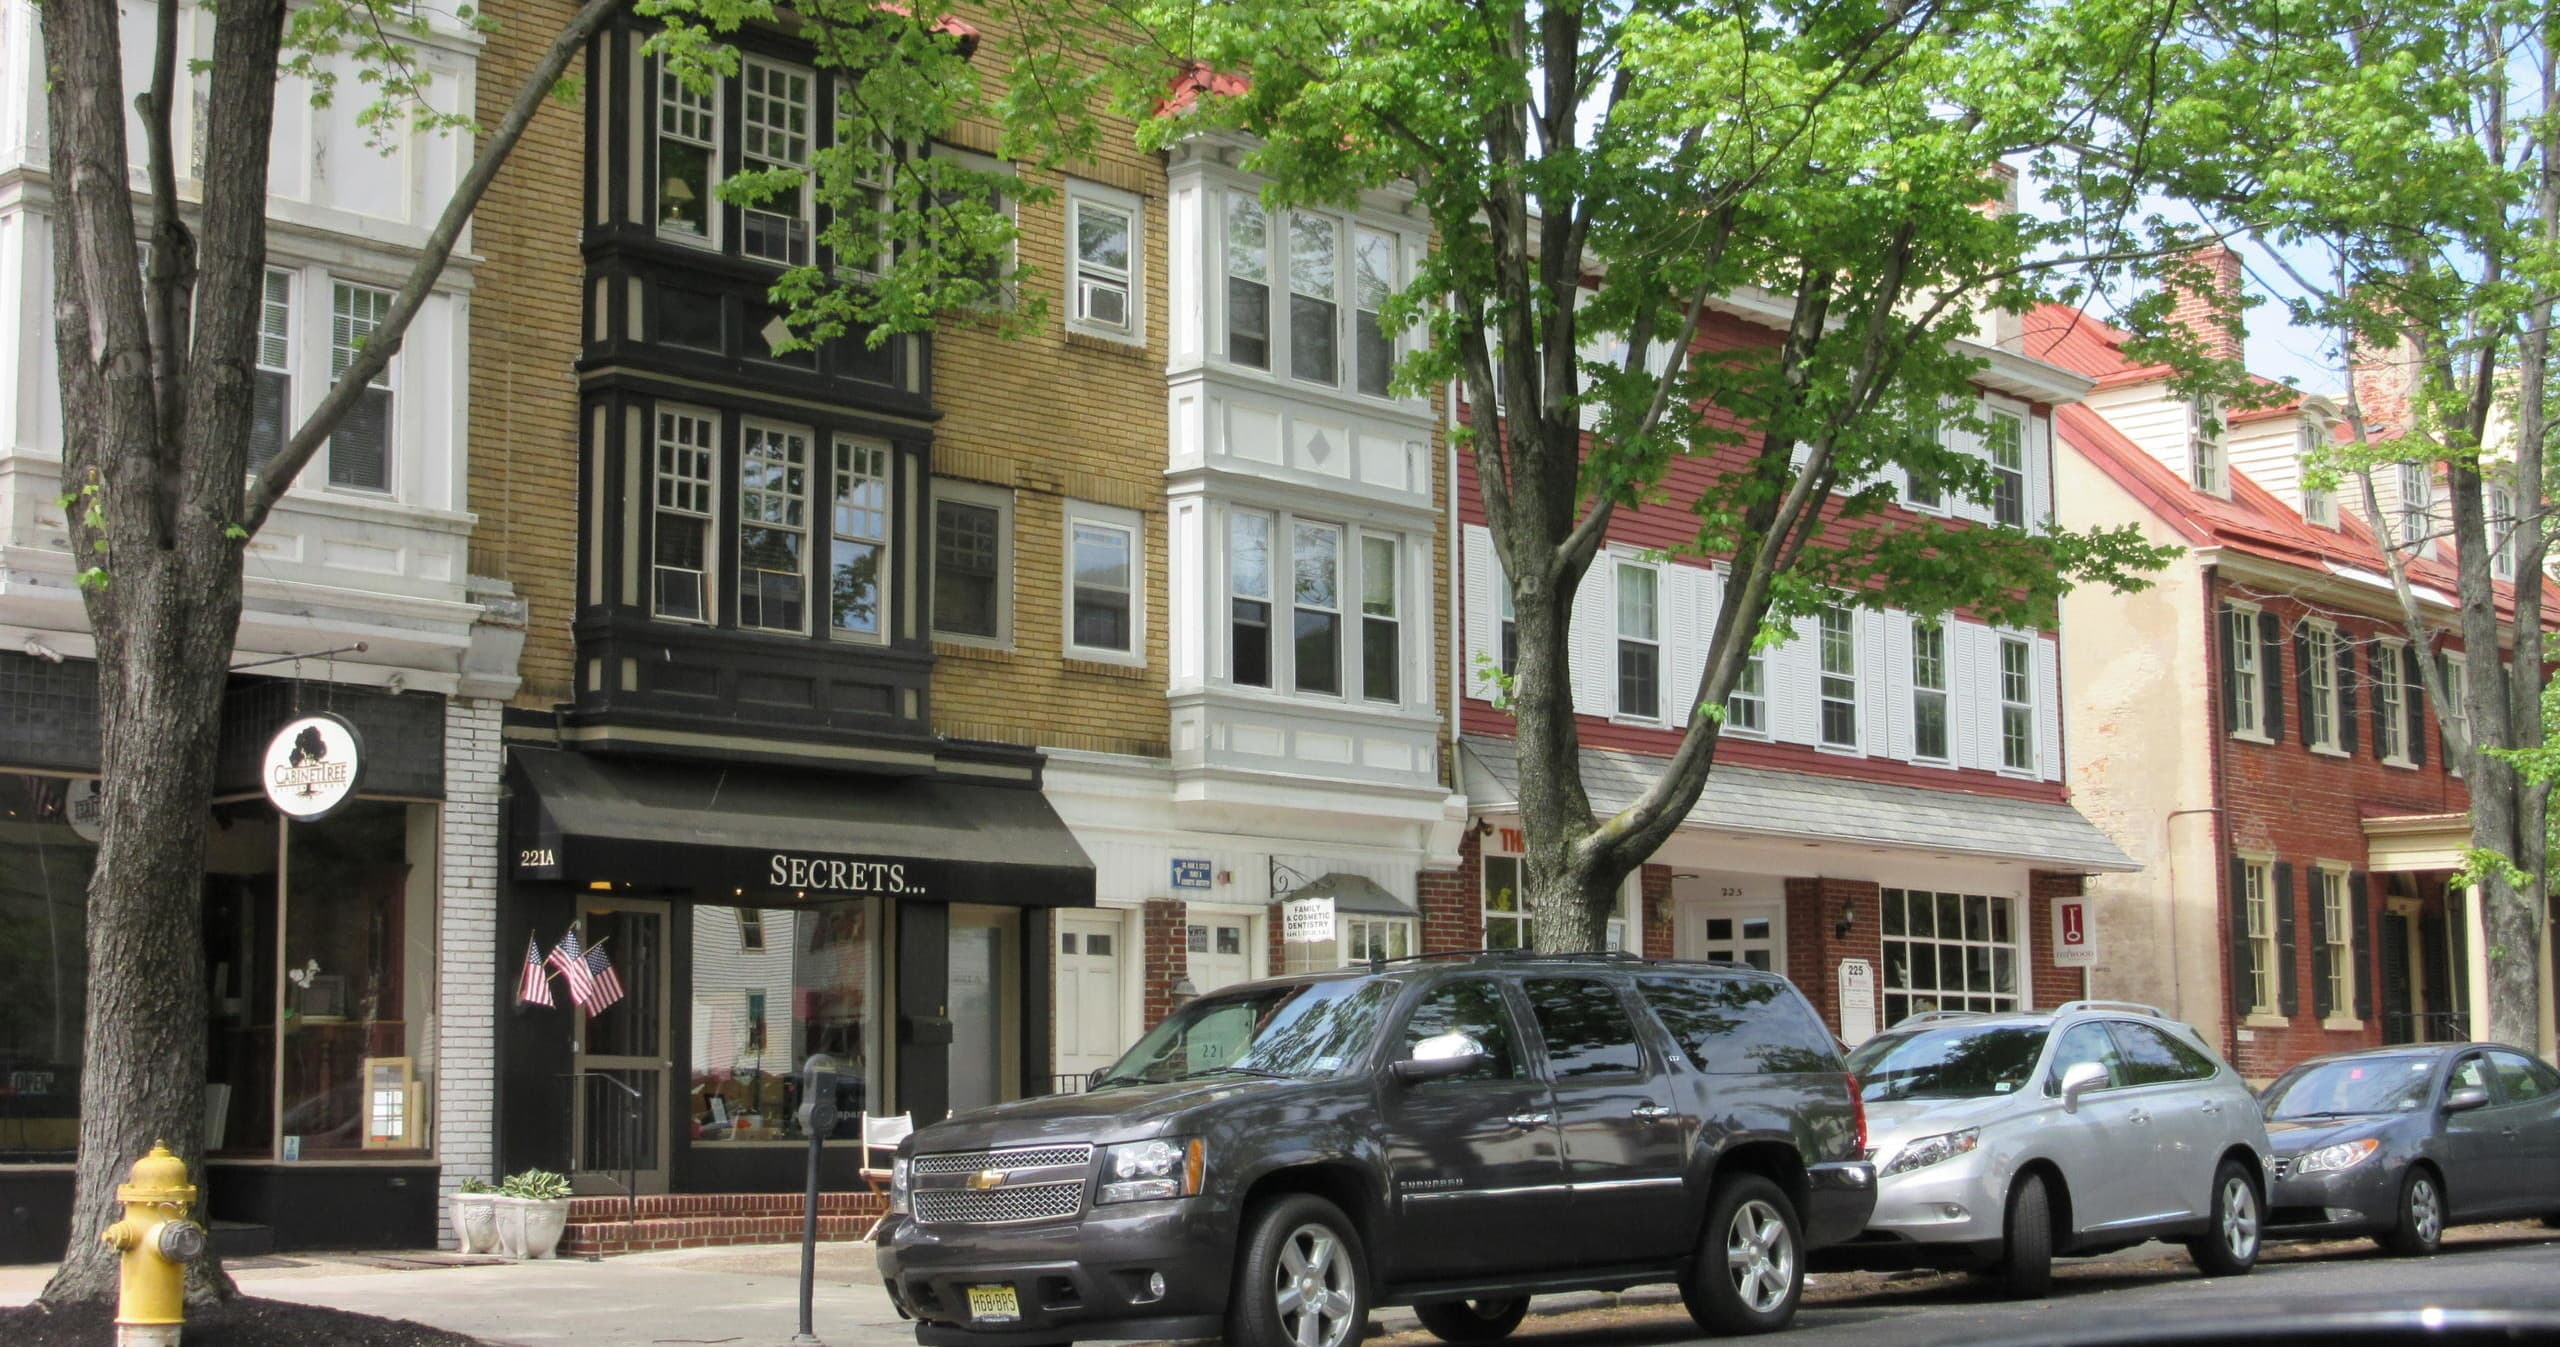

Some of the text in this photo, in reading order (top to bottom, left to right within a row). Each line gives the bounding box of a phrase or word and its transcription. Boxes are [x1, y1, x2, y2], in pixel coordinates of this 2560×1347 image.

[1500, 828, 1525, 853] TH
[521, 849, 555, 867] 221A
[1294, 904, 1320, 913] FAMILY
[1293, 911, 1331, 922] COSMETIC
[1288, 920, 1329, 930] DENTISTRY
[1848, 965, 1864, 976] 225
[1202, 1043, 1224, 1059] 221
